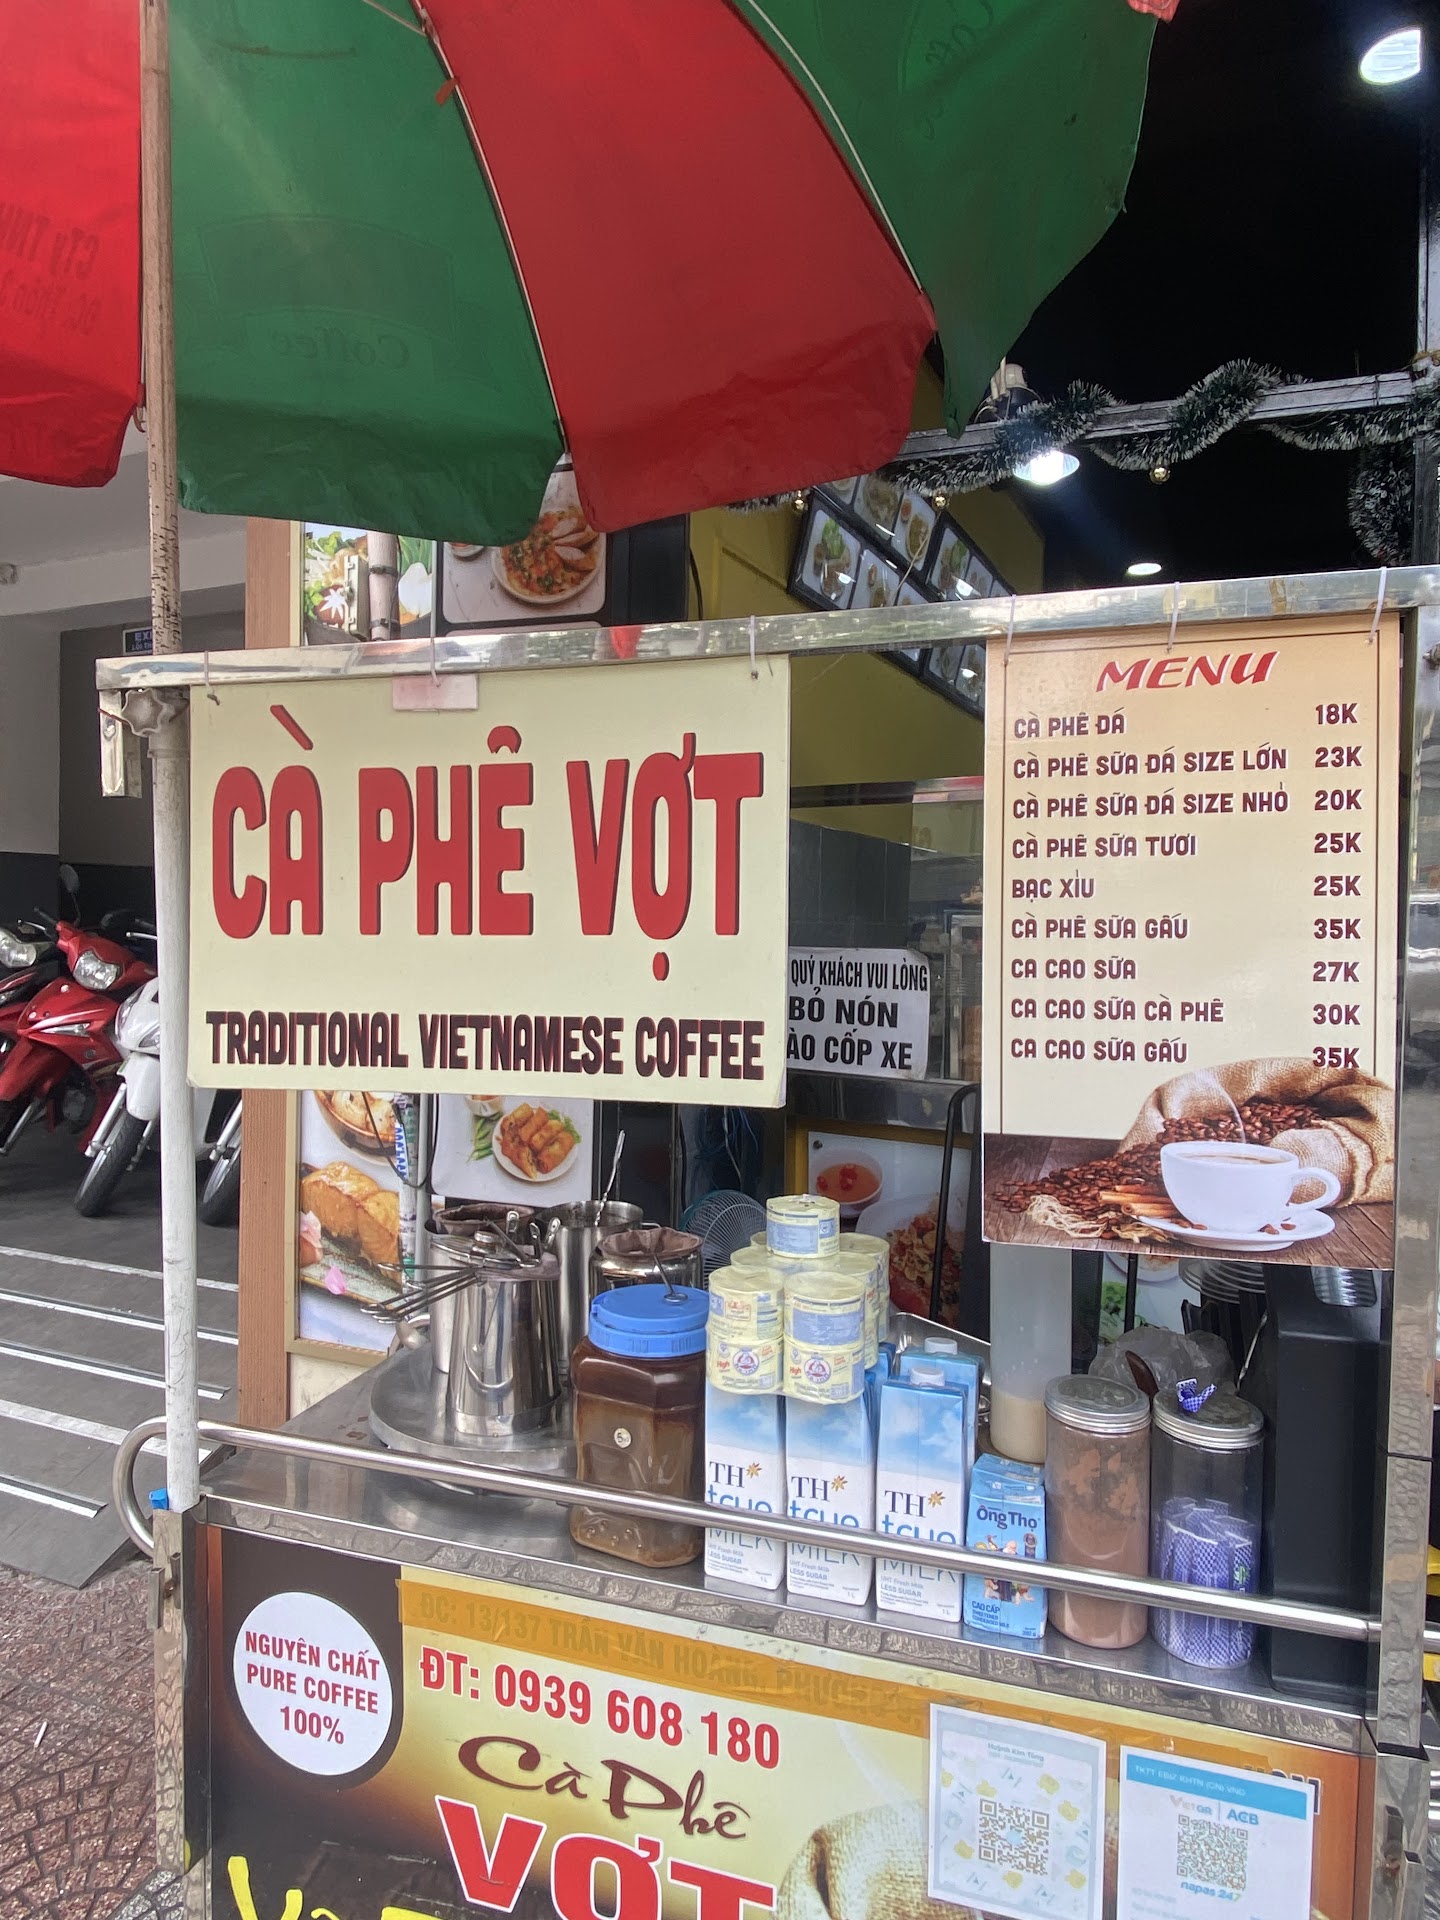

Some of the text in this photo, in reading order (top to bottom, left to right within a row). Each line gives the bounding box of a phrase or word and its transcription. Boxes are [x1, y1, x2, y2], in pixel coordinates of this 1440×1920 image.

[1096, 651, 1281, 692] MENU
[1014, 703, 1358, 739] CÀ PHÊ ĐÁ 18K
[1013, 742, 1362, 779] CÀ PHÊ SỮA ĐÁ SIZE LỚN 23K
[1013, 782, 1362, 819] CÀ PHÊ SỮA ĐÁ SIZE NHỎ 20K
[212, 705, 765, 981] CÀ PHÊ VỢT
[1012, 832, 1361, 859] CÀ PHÊ SỮA TƯƠI 25K
[1012, 870, 1361, 903] BẠC XỈU 25K
[1011, 911, 1361, 940] CÀ PHÊ SỮA GẤU 35K
[791, 955, 927, 991] QUÝ KHÁCH VUI LÒNG
[1011, 956, 1360, 982] CA CAO SỮA 27K
[789, 986, 898, 1028] BỎ NÓN
[1011, 993, 1360, 1025] CA CAO SỮA CÀ PHÊ 30K
[206, 1011, 765, 1080] TRADITIONAL VIETNAMESE COFFEE
[786, 1027, 913, 1069] ÀO CỐP XE
[1011, 1036, 1360, 1069] CA CAO SỮA GẤU 35K
[709, 1461, 745, 1488] TH
[791, 1476, 830, 1502] TH
[884, 1490, 926, 1518] TH
[976, 1504, 1038, 1532] Ông Thọ
[790, 1568, 828, 1580] LESS SUGAR
[880, 1582, 897, 1593] LESS
[898, 1587, 922, 1598] SUGAR
[971, 1600, 986, 1612] CAO
[245, 1631, 380, 1681] NGUYÊN CHẤT
[247, 1663, 378, 1714] PURE COFFEE
[280, 1706, 344, 1744] 100%
[420, 1647, 780, 1770] ĐT: 0939 608 180
[458, 1735, 750, 1841] Cà Phê
[1227, 1808, 1260, 1826] ACB
[1180, 1880, 1216, 1897] napas
[1218, 1889, 1243, 1901] 247
